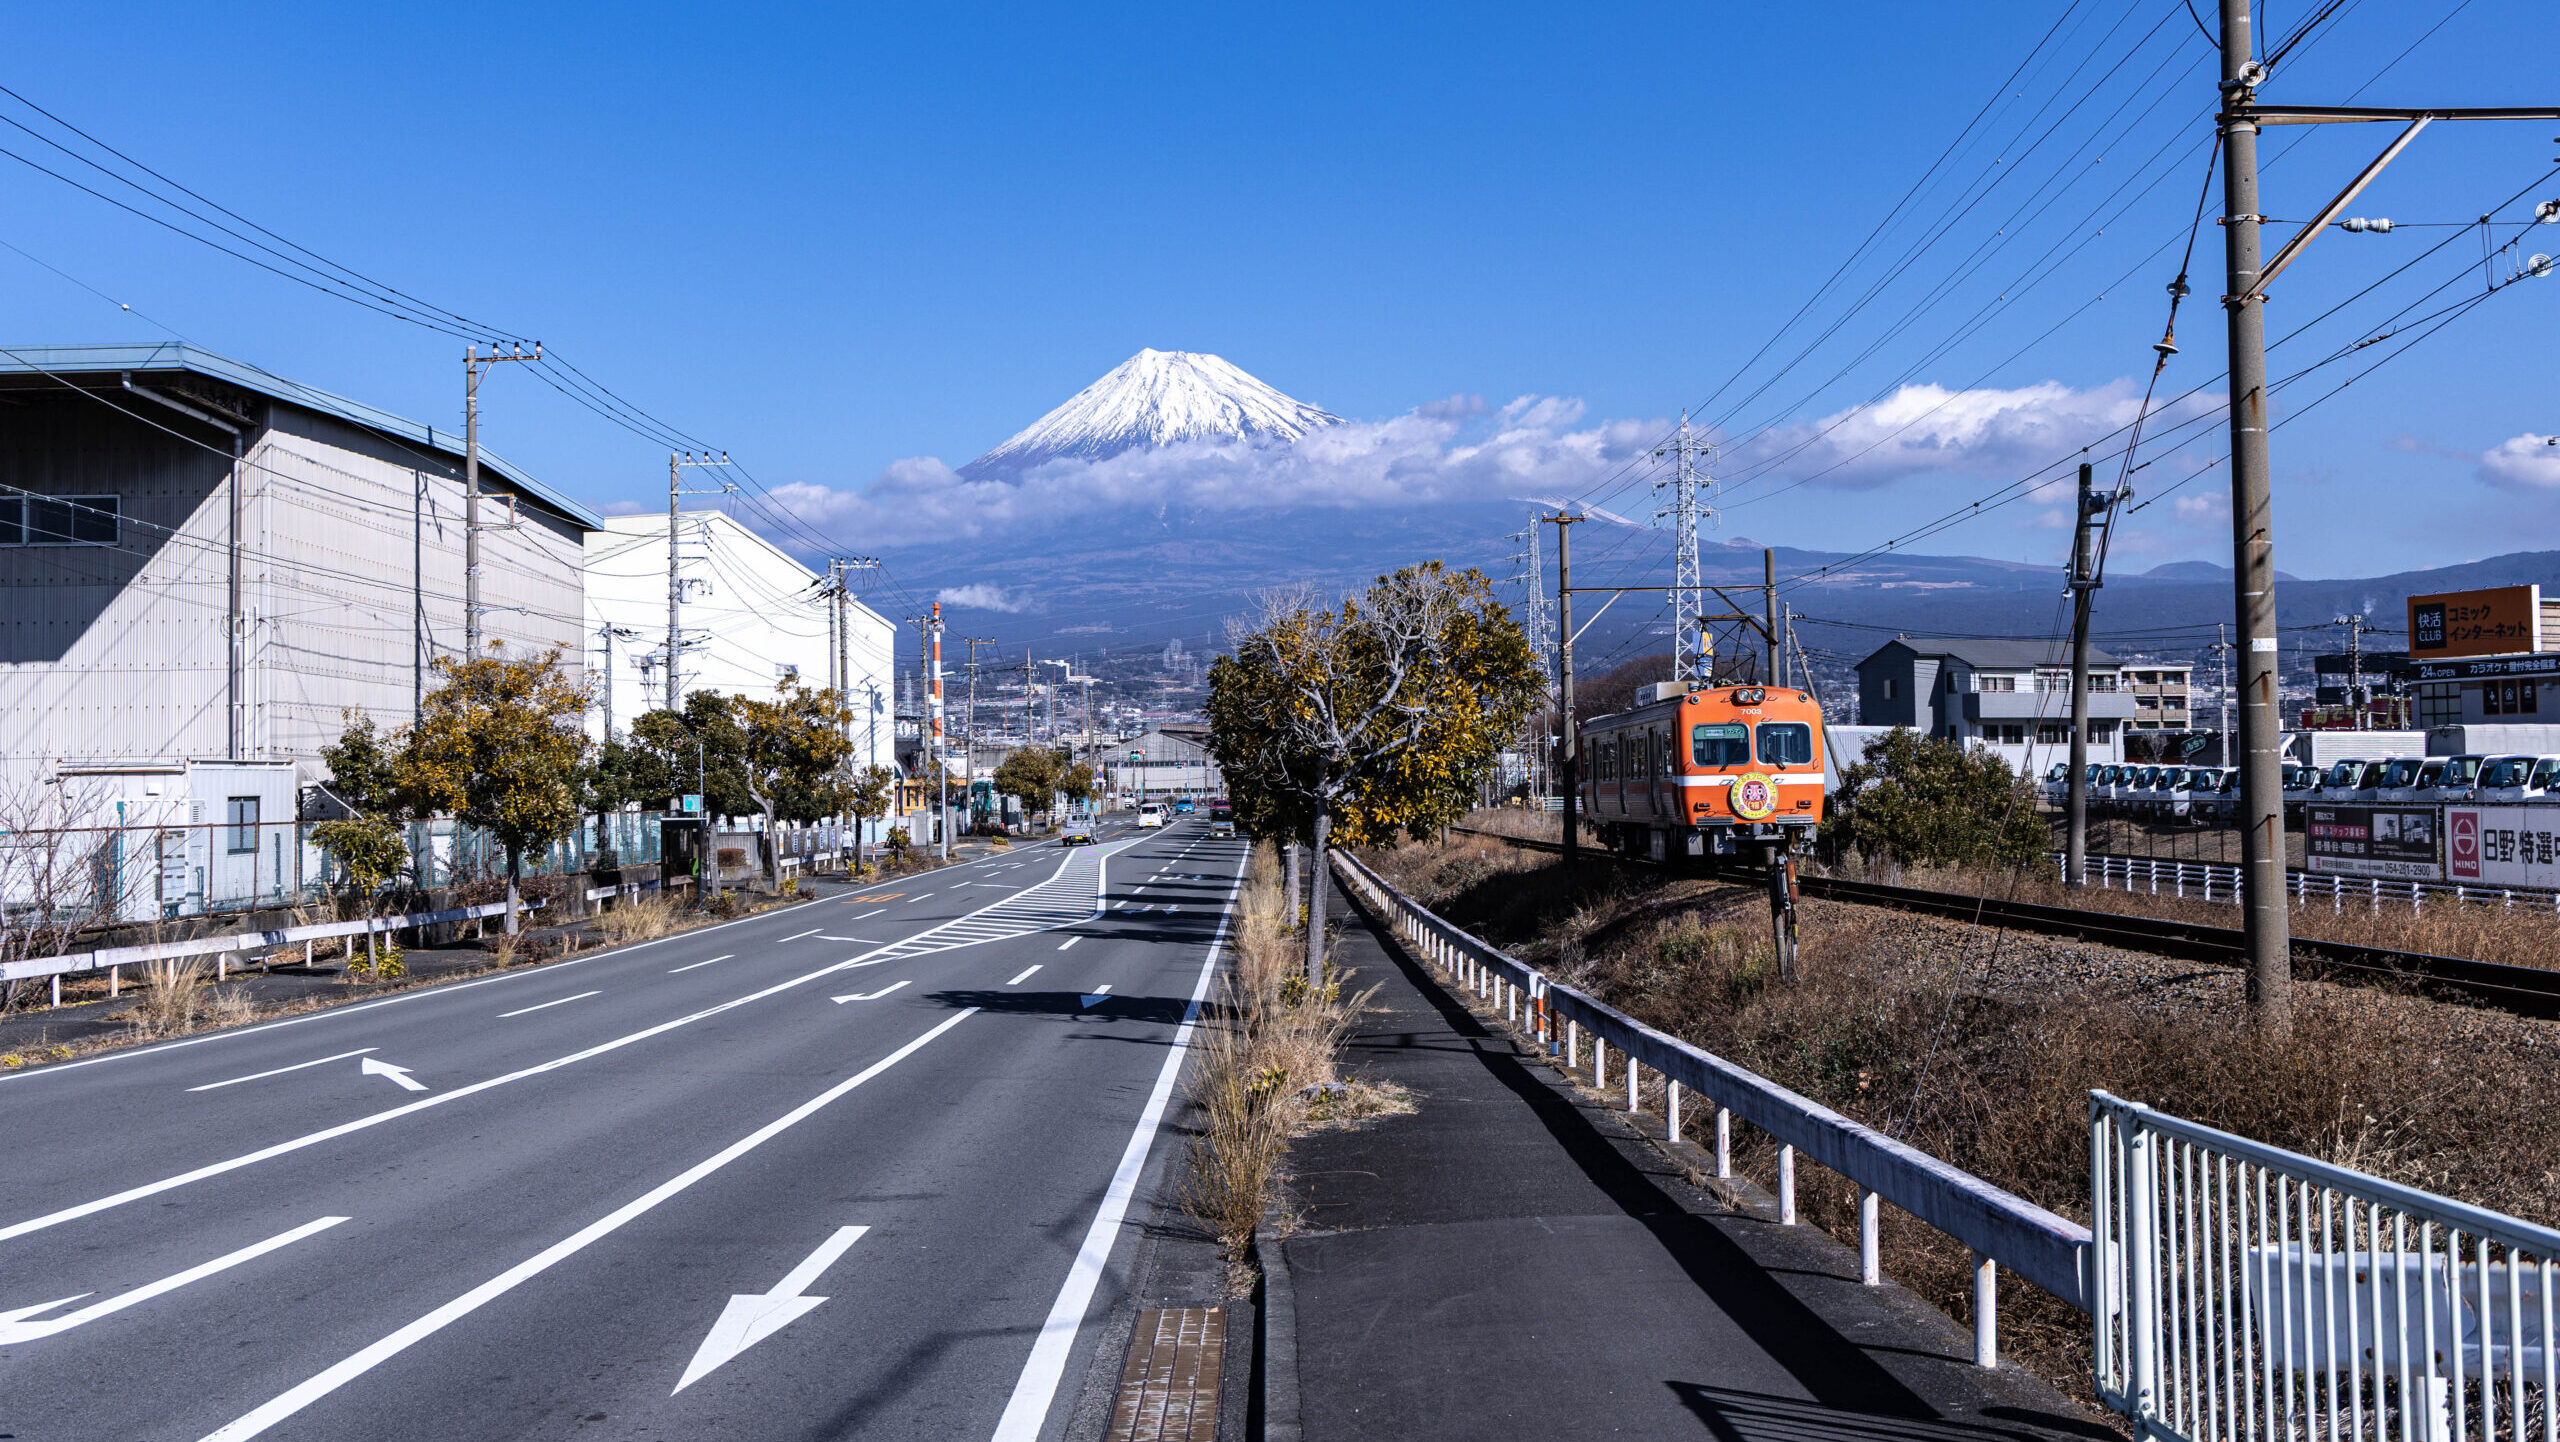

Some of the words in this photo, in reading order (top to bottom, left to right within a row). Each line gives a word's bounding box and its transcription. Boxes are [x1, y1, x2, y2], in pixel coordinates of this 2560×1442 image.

[2418, 611, 2441, 629] 快活
[2448, 605, 2490, 622] コミック
[2419, 629, 2442, 642] CLUB
[2450, 622, 2527, 641] インターネット
[2437, 668, 2456, 677] OPEN
[2455, 860, 2477, 870] HINO
